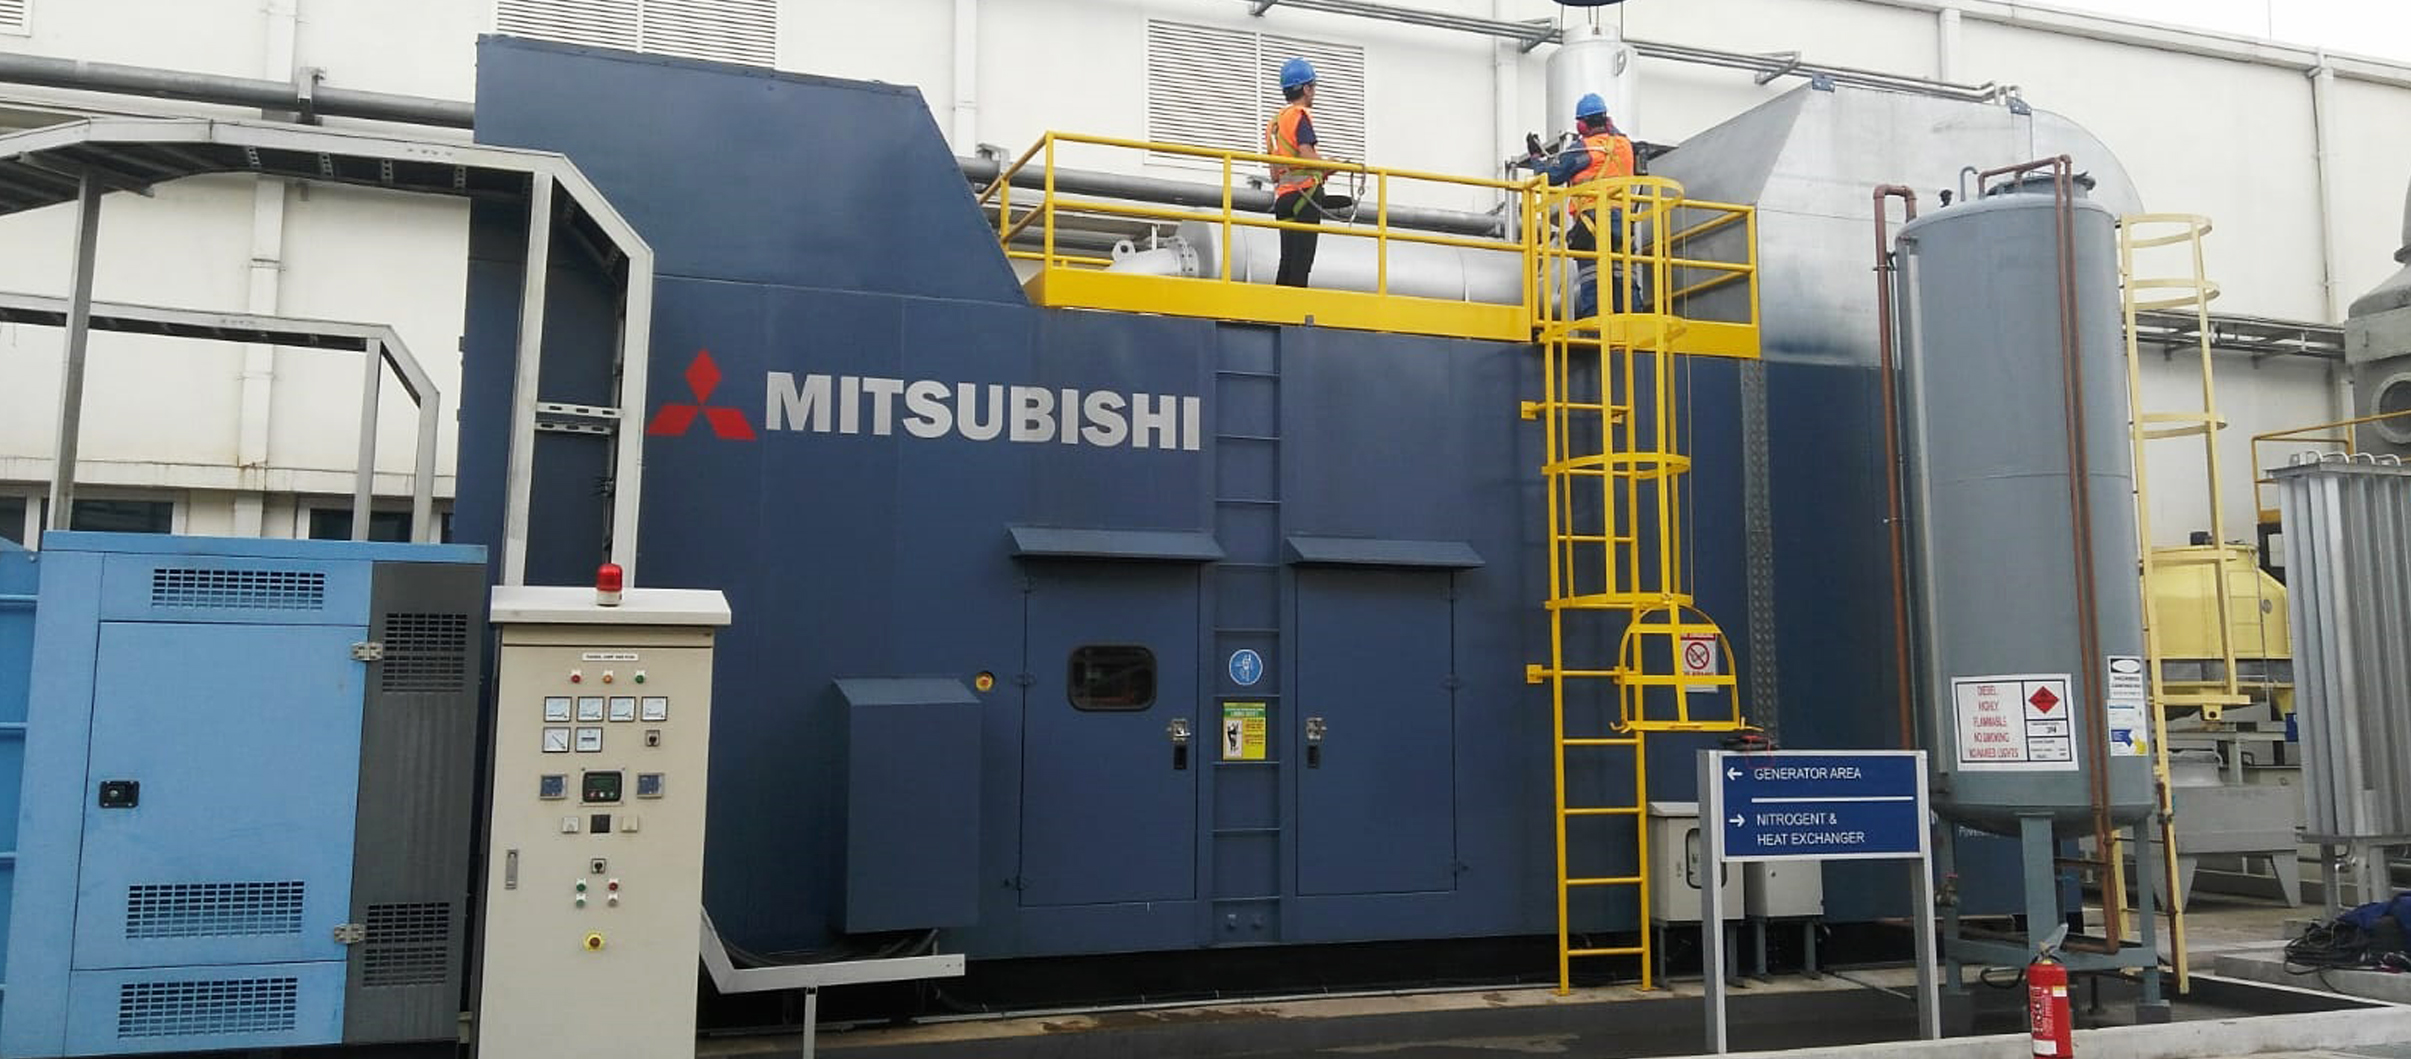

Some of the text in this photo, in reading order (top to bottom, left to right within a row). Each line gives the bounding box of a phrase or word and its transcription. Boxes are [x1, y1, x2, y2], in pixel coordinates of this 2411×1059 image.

[765, 371, 1200, 451] MITSUBISHI
[1754, 767, 1862, 780] GENERATOR AREA
[1756, 812, 1838, 826] NITROGENT &
[1757, 832, 1865, 846] HEAT EXCHANGER
